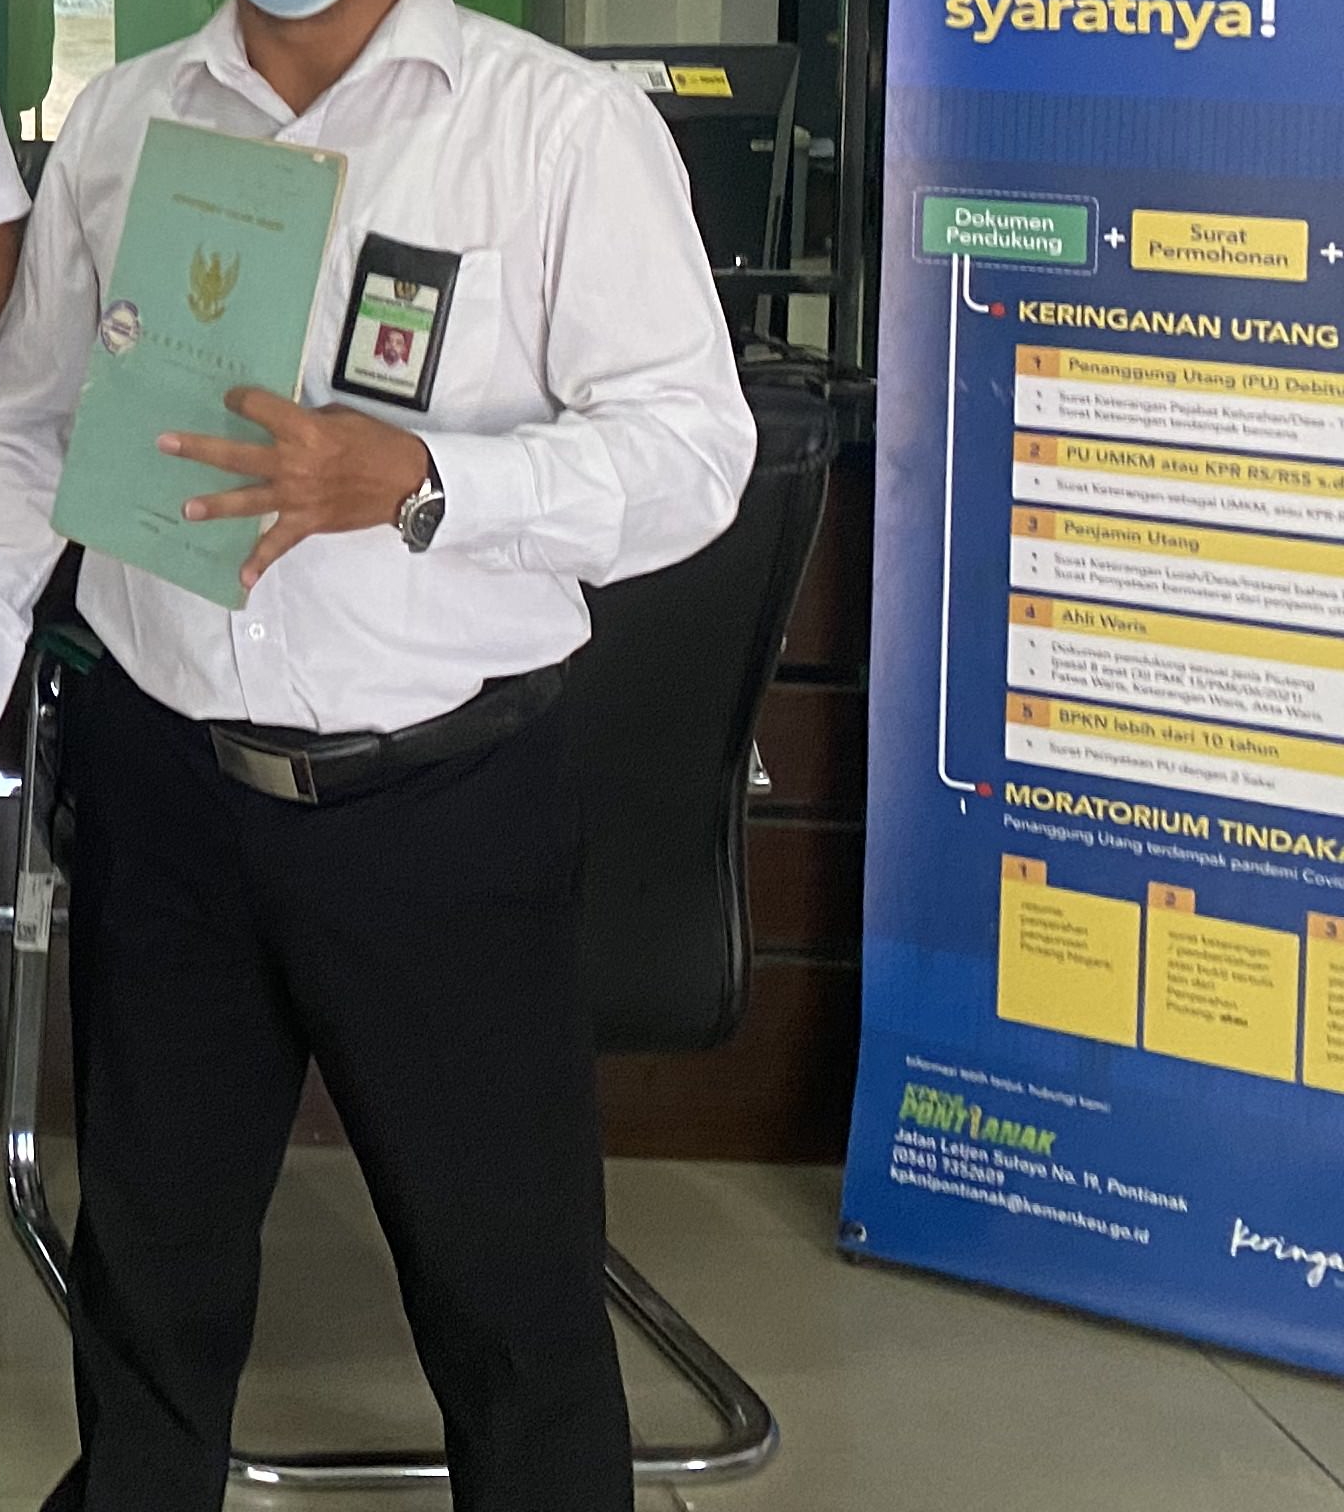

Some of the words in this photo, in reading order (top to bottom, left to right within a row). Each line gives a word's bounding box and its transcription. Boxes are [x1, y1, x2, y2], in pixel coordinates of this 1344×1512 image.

[955, 207, 1055, 233] Dokumen
[1190, 223, 1247, 245] Surat
[946, 227, 1063, 256] Pendukung
[1148, 240, 1289, 269] Permohonan
[1018, 299, 1222, 339] KERINGANAN
[1231, 317, 1340, 350] UTANG
[1068, 357, 1177, 383] Penanggung
[1183, 368, 1236, 389] Utang
[1066, 445, 1089, 462] PU
[1096, 449, 1156, 469] UMKM
[1205, 461, 1241, 480] KPR
[1064, 519, 1142, 544] Penjamin
[1148, 530, 1200, 553] Utang
[1229, 735, 1280, 759] tahun
[1004, 781, 1210, 840] MORATORIUM
[1003, 813, 1094, 847] Penanggung
[1097, 831, 1143, 856] Utang
[1147, 840, 1226, 868] terdampak
[1230, 857, 1298, 881] pandemi
[893, 1127, 937, 1152] Jalan
[940, 1137, 990, 1164] Letjen
[992, 1149, 1048, 1178] Sutoyo
[1107, 1176, 1189, 1214] Pontianak
